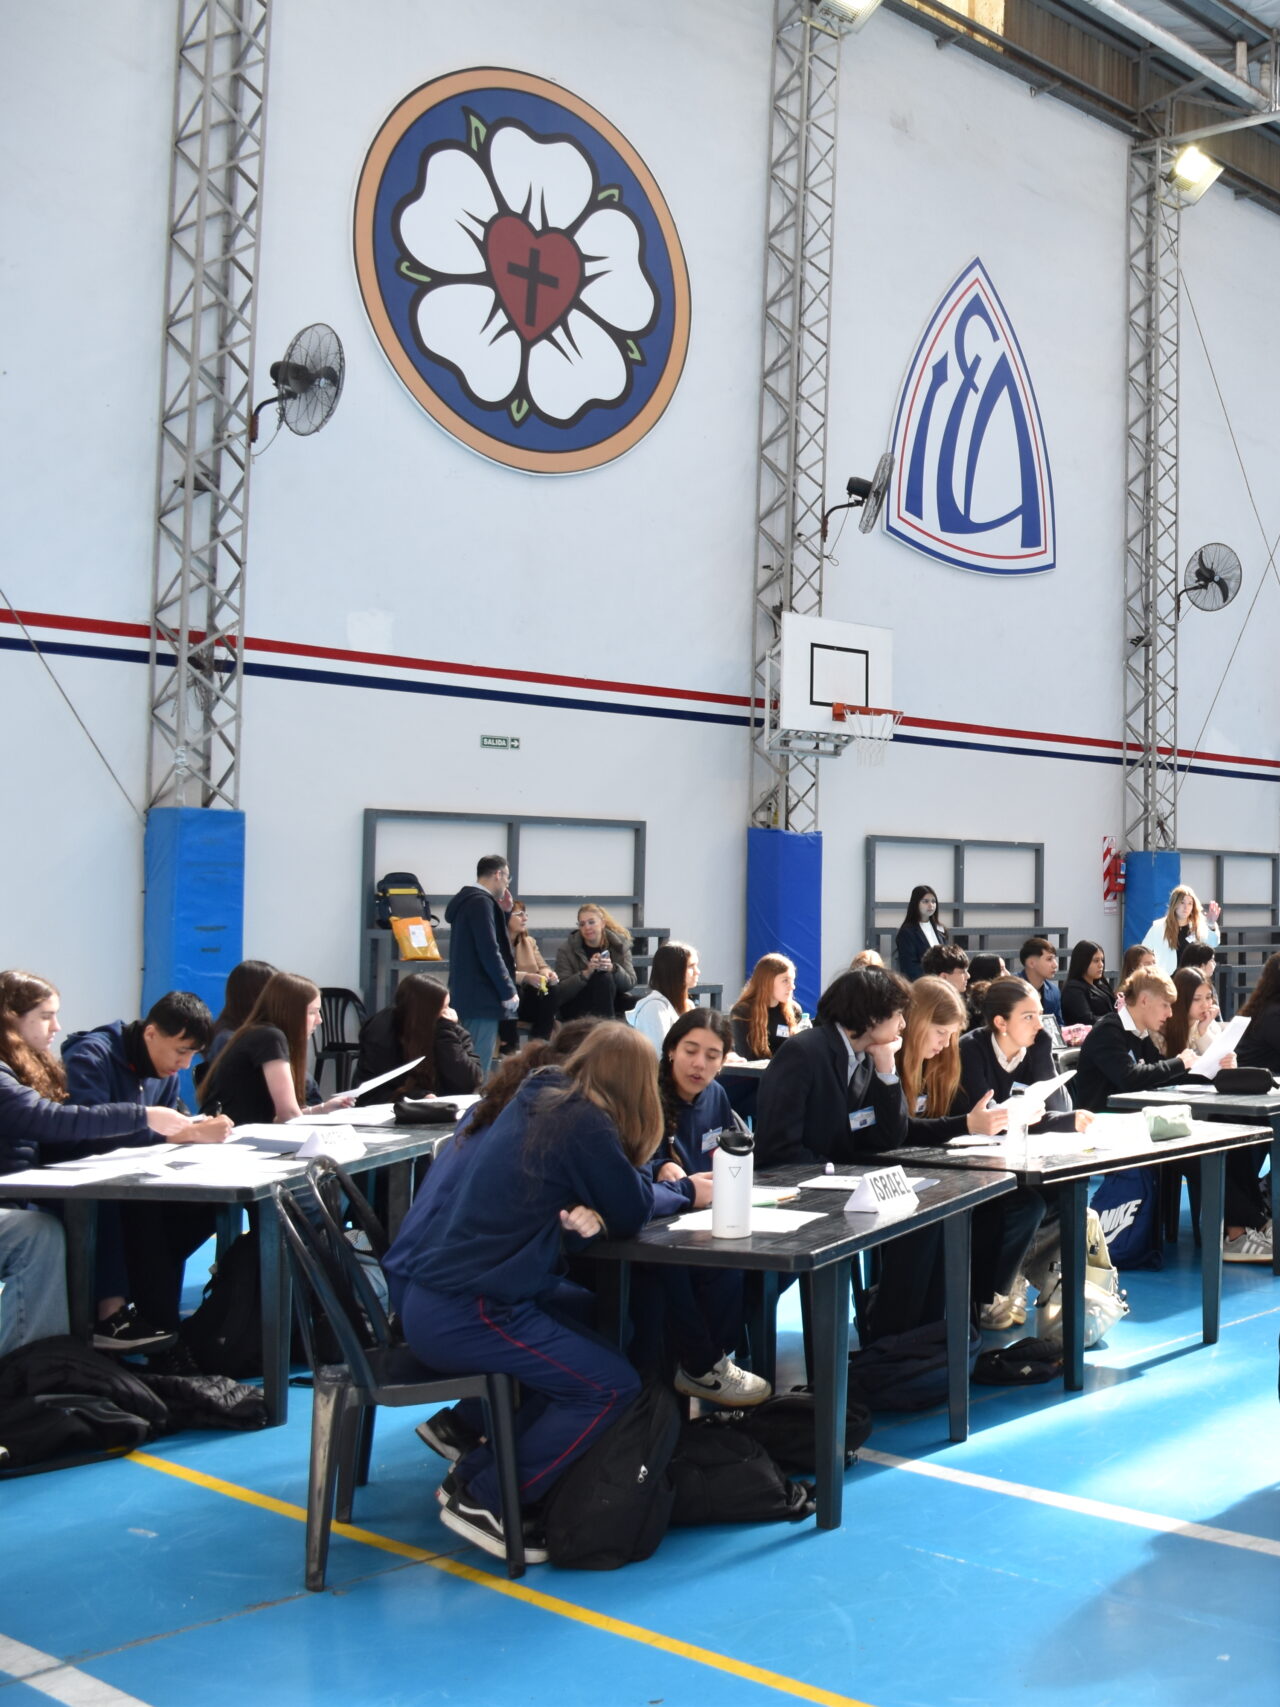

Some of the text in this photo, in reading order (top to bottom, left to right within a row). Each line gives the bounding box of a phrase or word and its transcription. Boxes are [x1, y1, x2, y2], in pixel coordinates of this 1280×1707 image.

[483, 738, 507, 746] SALIDA
[869, 1171, 911, 1202] ISRAEL
[1100, 1199, 1142, 1233] NIKE
